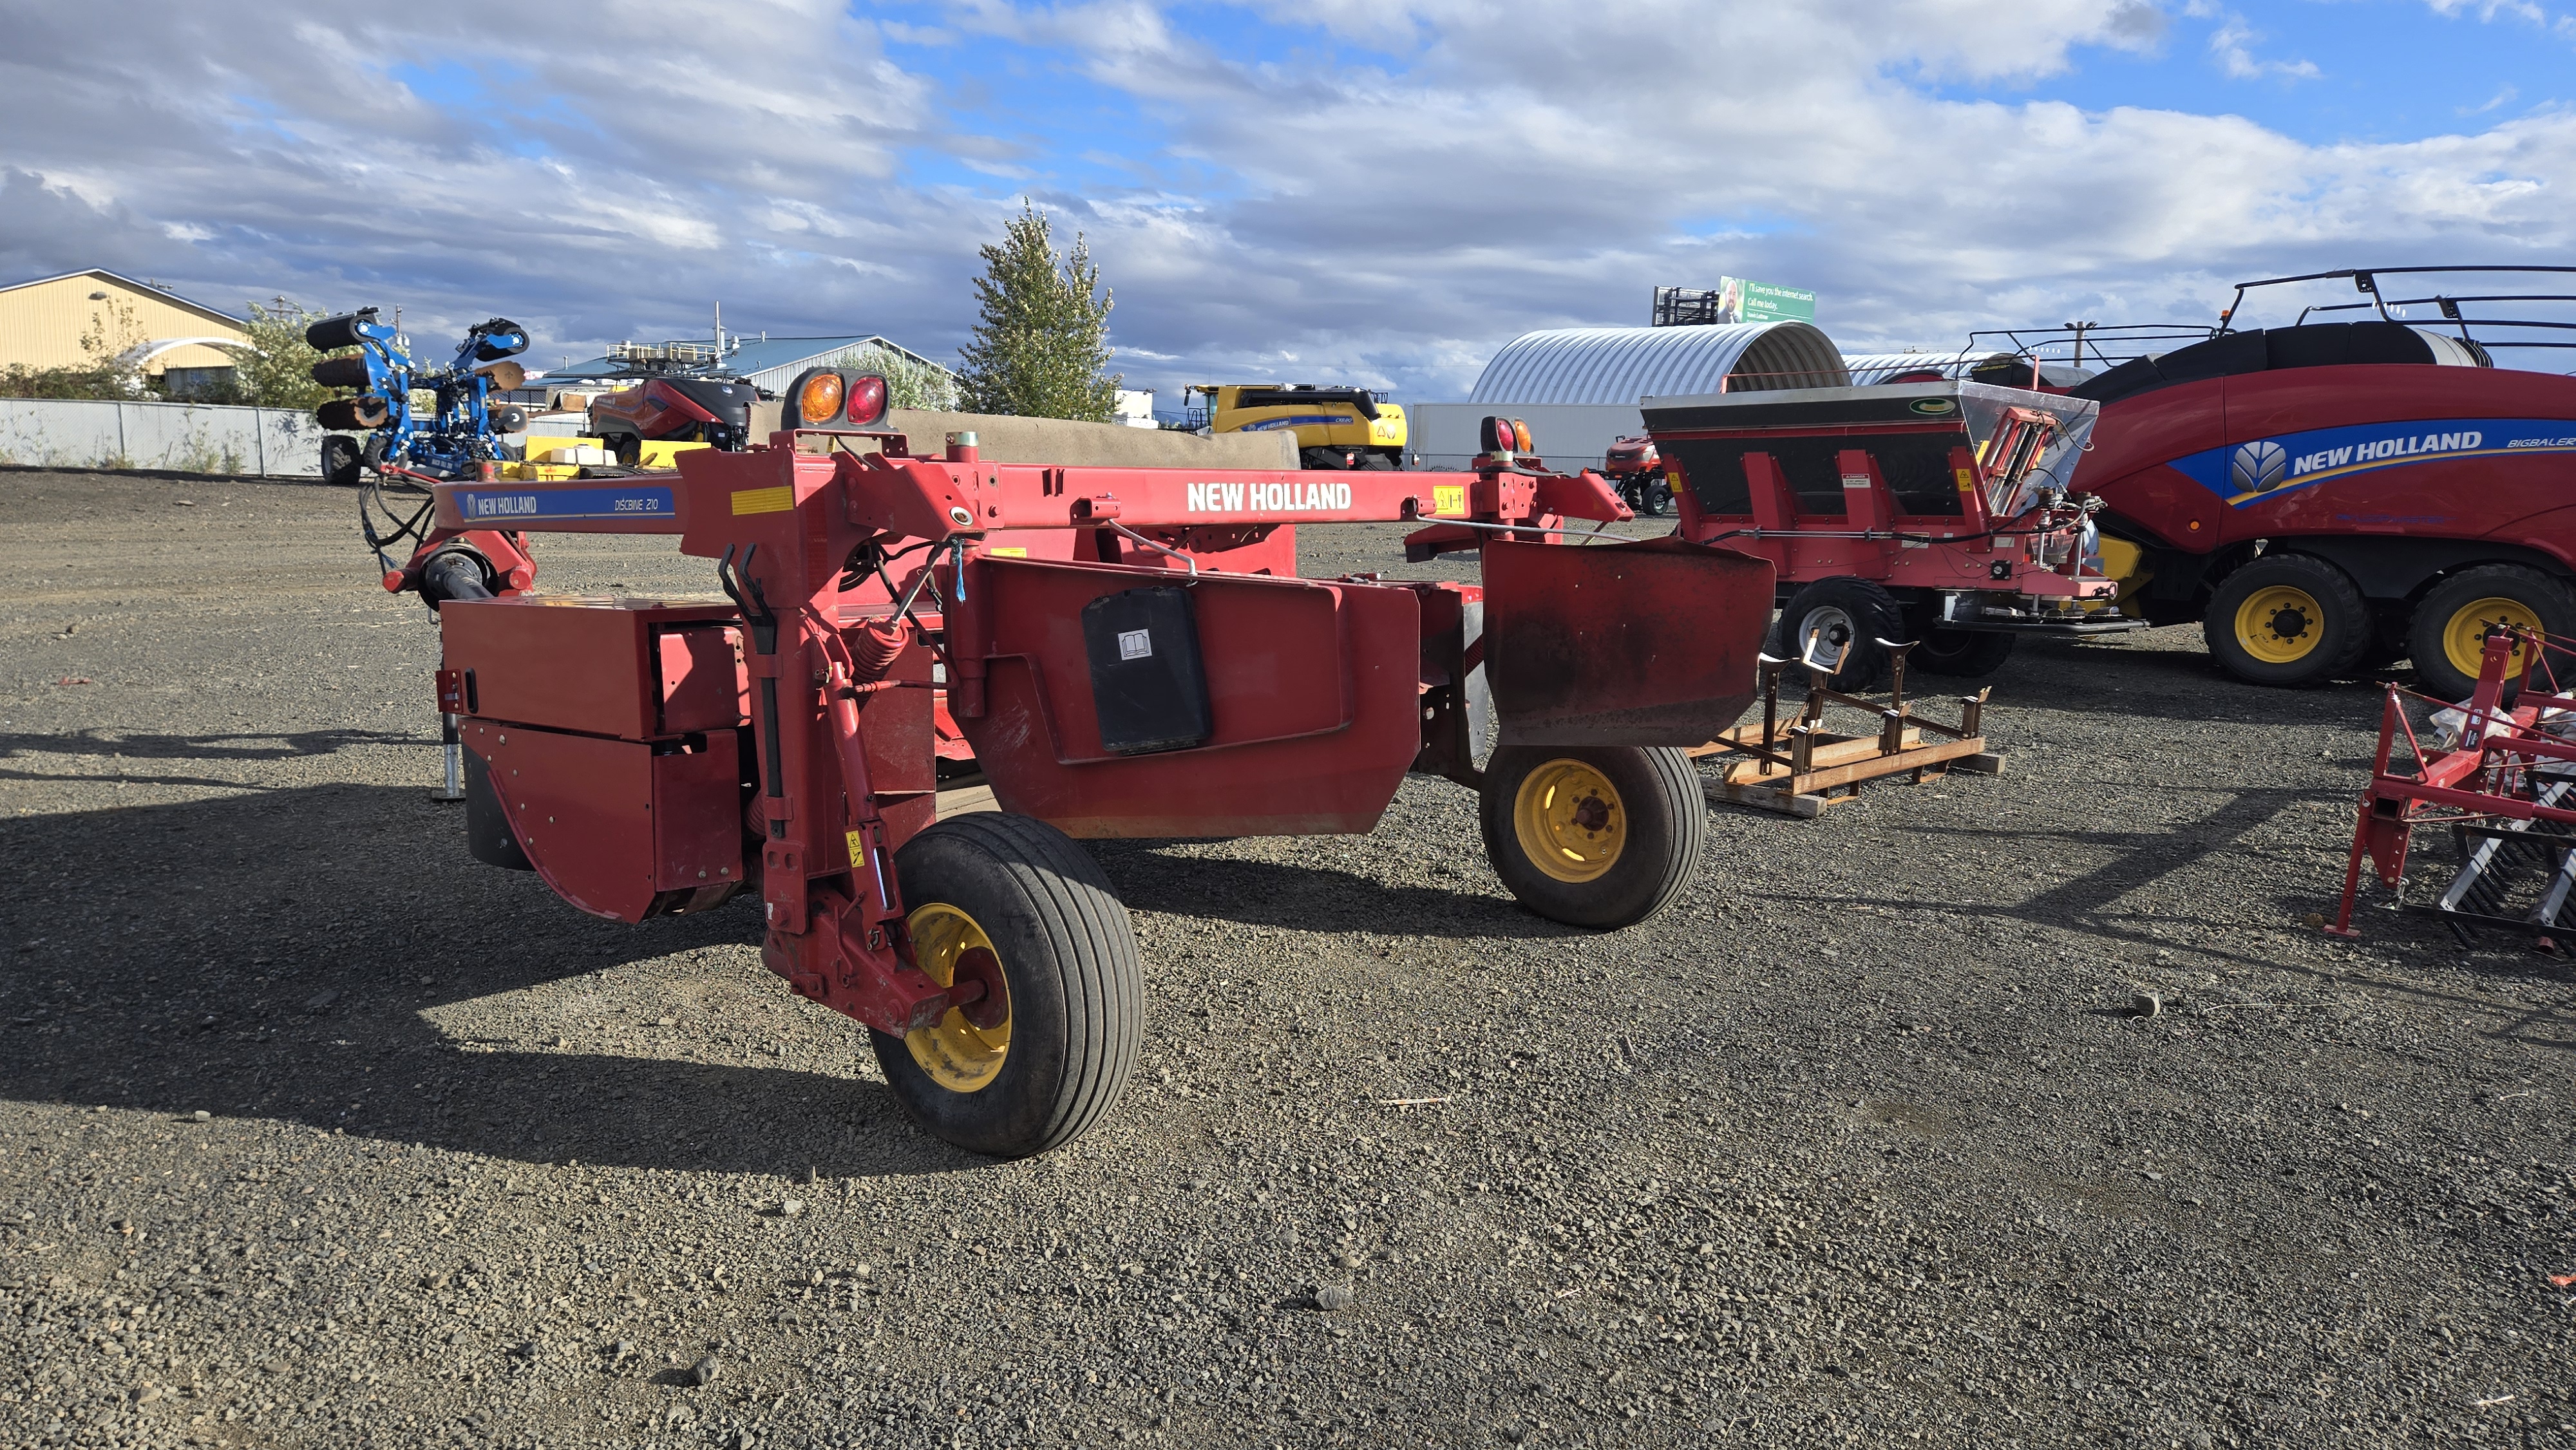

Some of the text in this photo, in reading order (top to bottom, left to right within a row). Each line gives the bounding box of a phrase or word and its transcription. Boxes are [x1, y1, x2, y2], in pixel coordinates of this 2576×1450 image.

[1766, 287, 1774, 296] you
[1782, 288, 1799, 299] internet
[1799, 292, 1814, 301] search.
[1748, 297, 1756, 306] Call
[1765, 301, 1777, 311] today.
[1268, 420, 1289, 429] HOLLAND
[2507, 438, 2576, 448] BIGBALER
[2293, 431, 2482, 475] NEW HOLLAND
[614, 498, 658, 511] DISCBINE 210
[1187, 483, 1352, 512] NEW HOLLAND
[478, 496, 537, 515] NEW HOLLAND
